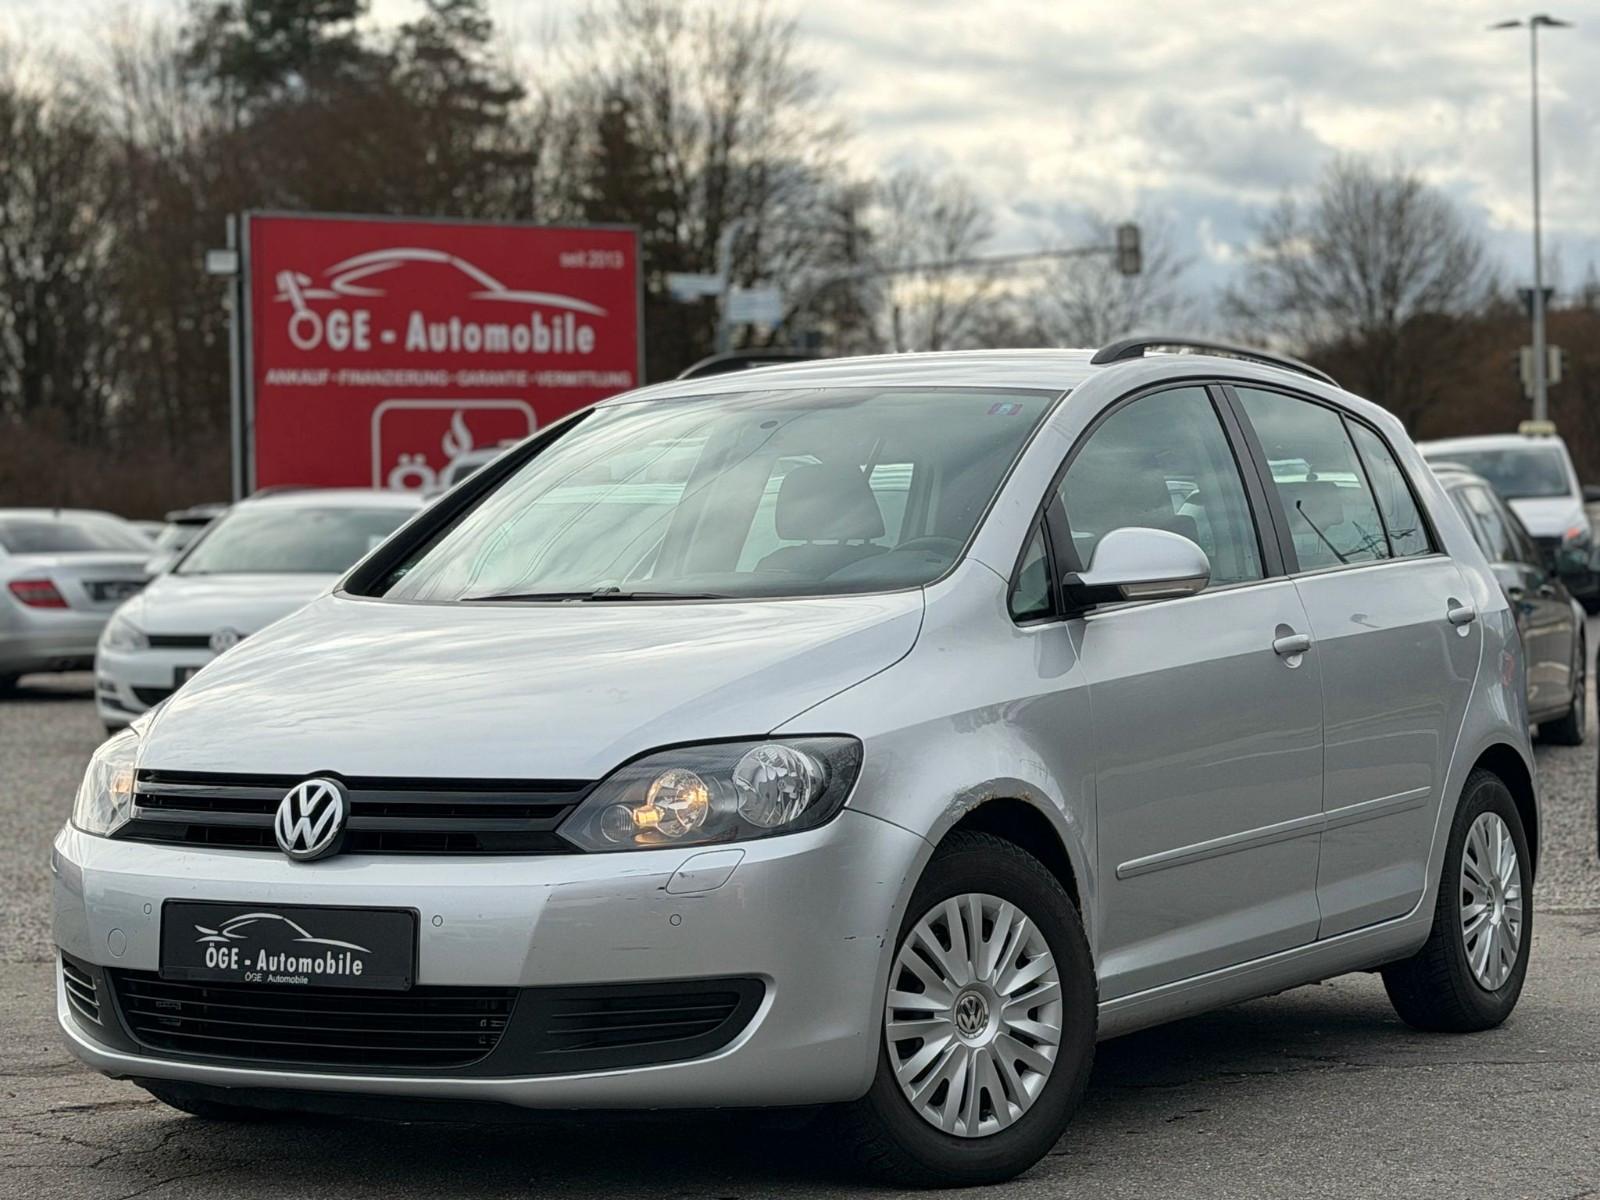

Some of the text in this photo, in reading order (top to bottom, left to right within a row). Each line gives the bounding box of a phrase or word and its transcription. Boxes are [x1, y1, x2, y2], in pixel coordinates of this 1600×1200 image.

[405, 310, 595, 353] Automobile
[206, 942, 239, 970] ÖGE
[256, 949, 363, 975] Automobile
[267, 973, 309, 985] Automobile
